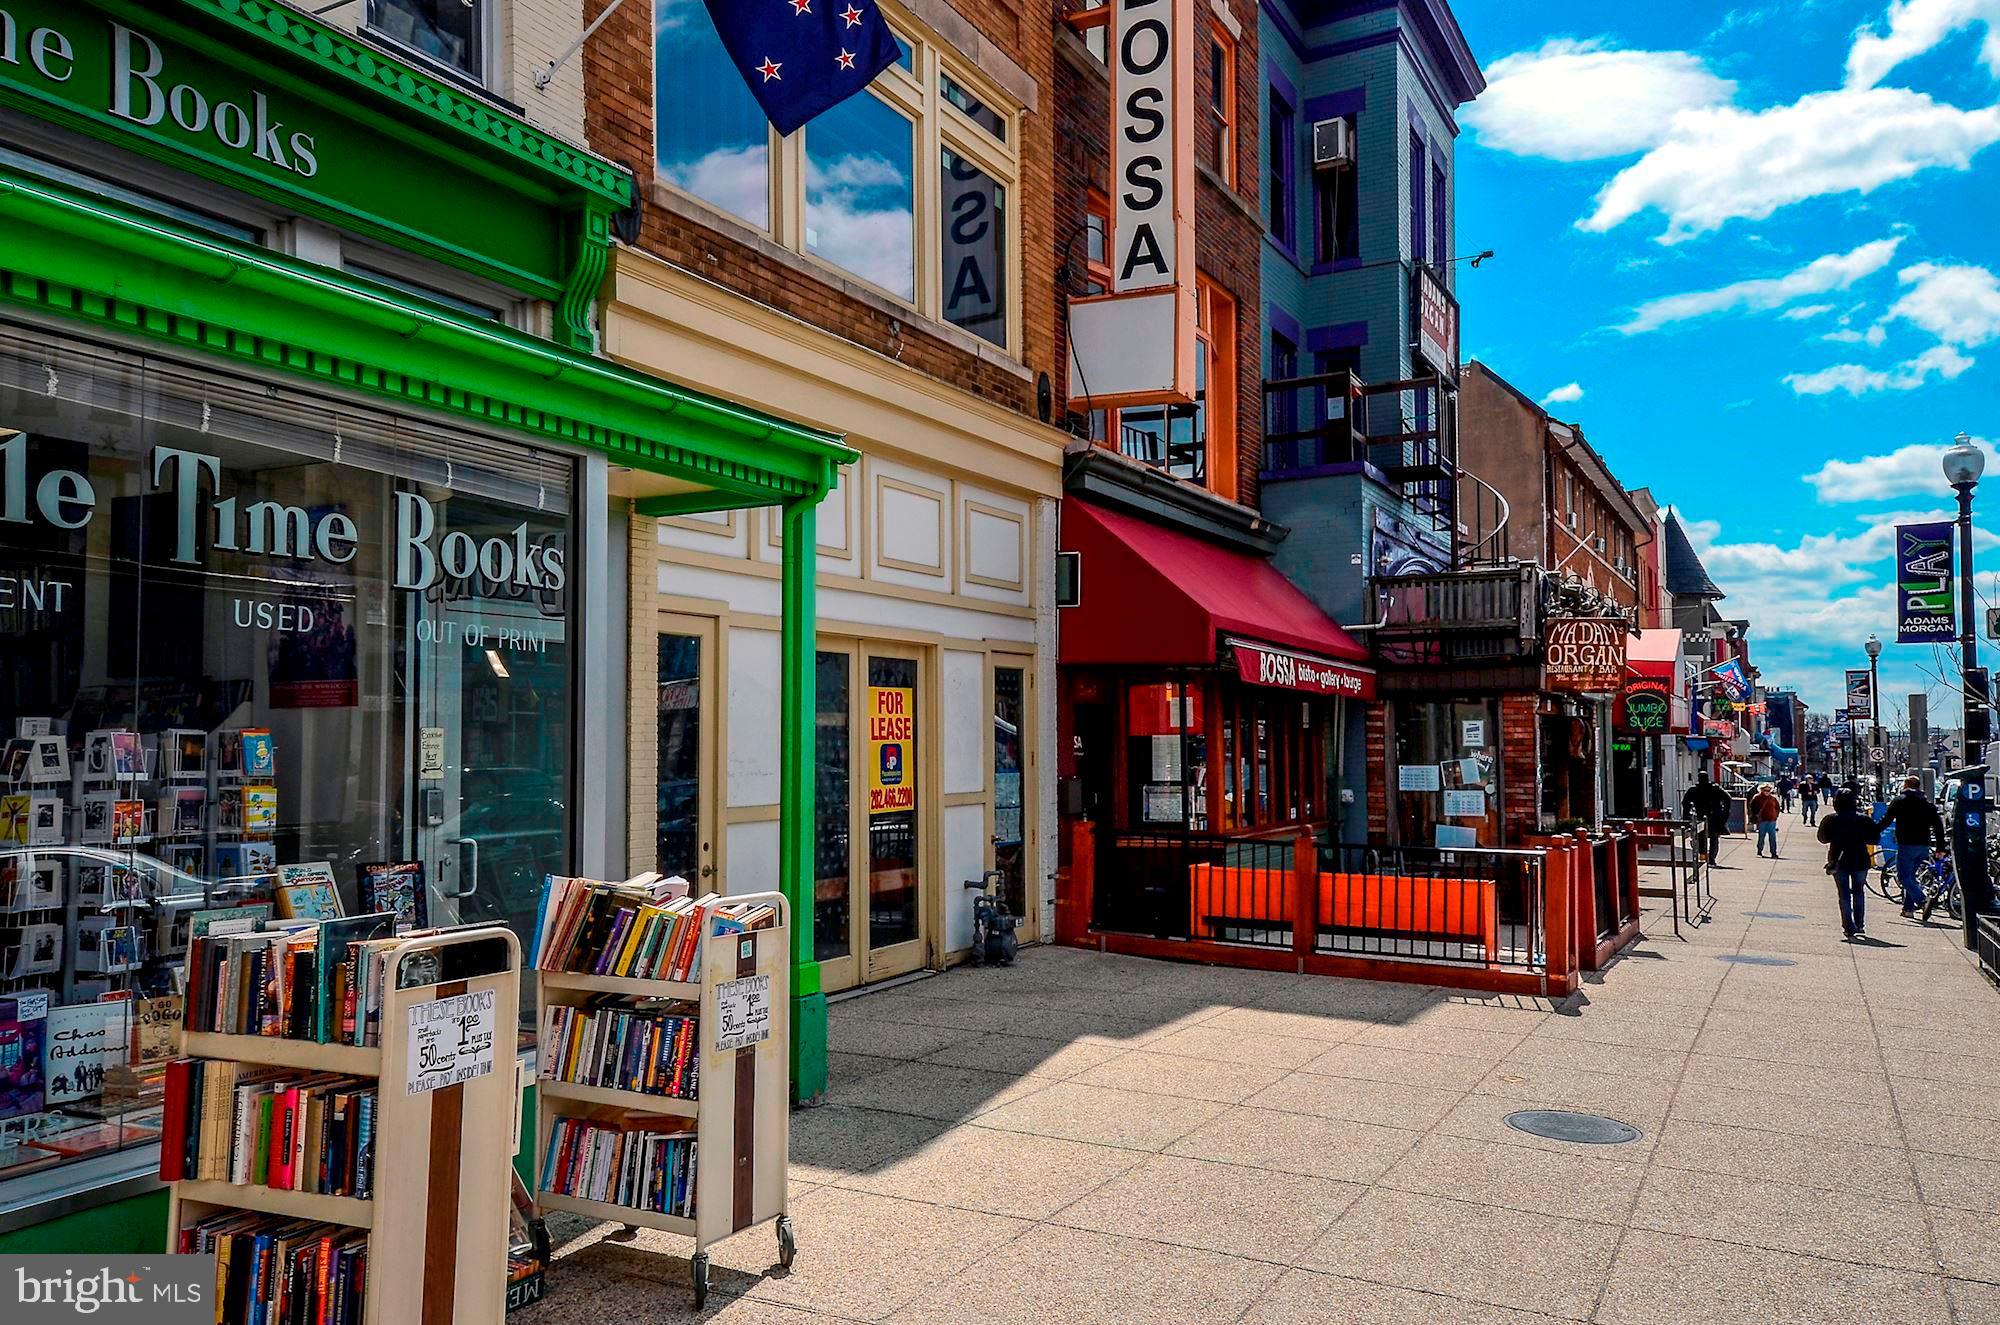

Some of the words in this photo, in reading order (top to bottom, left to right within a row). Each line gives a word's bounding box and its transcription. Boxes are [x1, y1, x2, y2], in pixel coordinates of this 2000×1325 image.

[108, 19, 319, 178] Books
[1119, 0, 1170, 281] OSSA
[150, 445, 358, 564] Time
[393, 491, 567, 592] Books
[1903, 532, 1950, 612] PLAY
[234, 599, 315, 633] USED
[1899, 624, 1955, 633] MORGAN
[1904, 616, 1950, 625] ADAMS
[416, 617, 460, 645] OUT
[465, 623, 490, 649] OF
[497, 629, 548, 654] PRINT
[1547, 644, 1625, 667] ORGAN
[1260, 651, 1297, 687] BOSSA
[1546, 664, 1588, 674] RESTAURANT
[1598, 664, 1618, 674] BAR
[1625, 681, 1668, 694] ORIGINAL
[1847, 671, 1871, 709] EAT
[877, 691, 904, 715] FOR
[1626, 702, 1668, 714] JUMBO
[870, 716, 912, 741] LEASE
[1629, 715, 1664, 728] SLICE
[1470, 750, 1494, 763] where
[1969, 784, 1981, 800] P
[715, 979, 745, 1000] THESE
[745, 974, 770, 994] BOOKS
[140, 1008, 182, 1026] POGO
[408, 998, 455, 1026] THESE
[456, 990, 494, 1017] BOOKS
[721, 1013, 734, 1032] 50
[471, 1034, 483, 1044] PLUS
[418, 1043, 438, 1069] 50
[437, 1052, 456, 1065] cents
[407, 1076, 436, 1096] PLEASE
[439, 1071, 453, 1088] PAY
[233, 1100, 245, 1151] CENTURY
